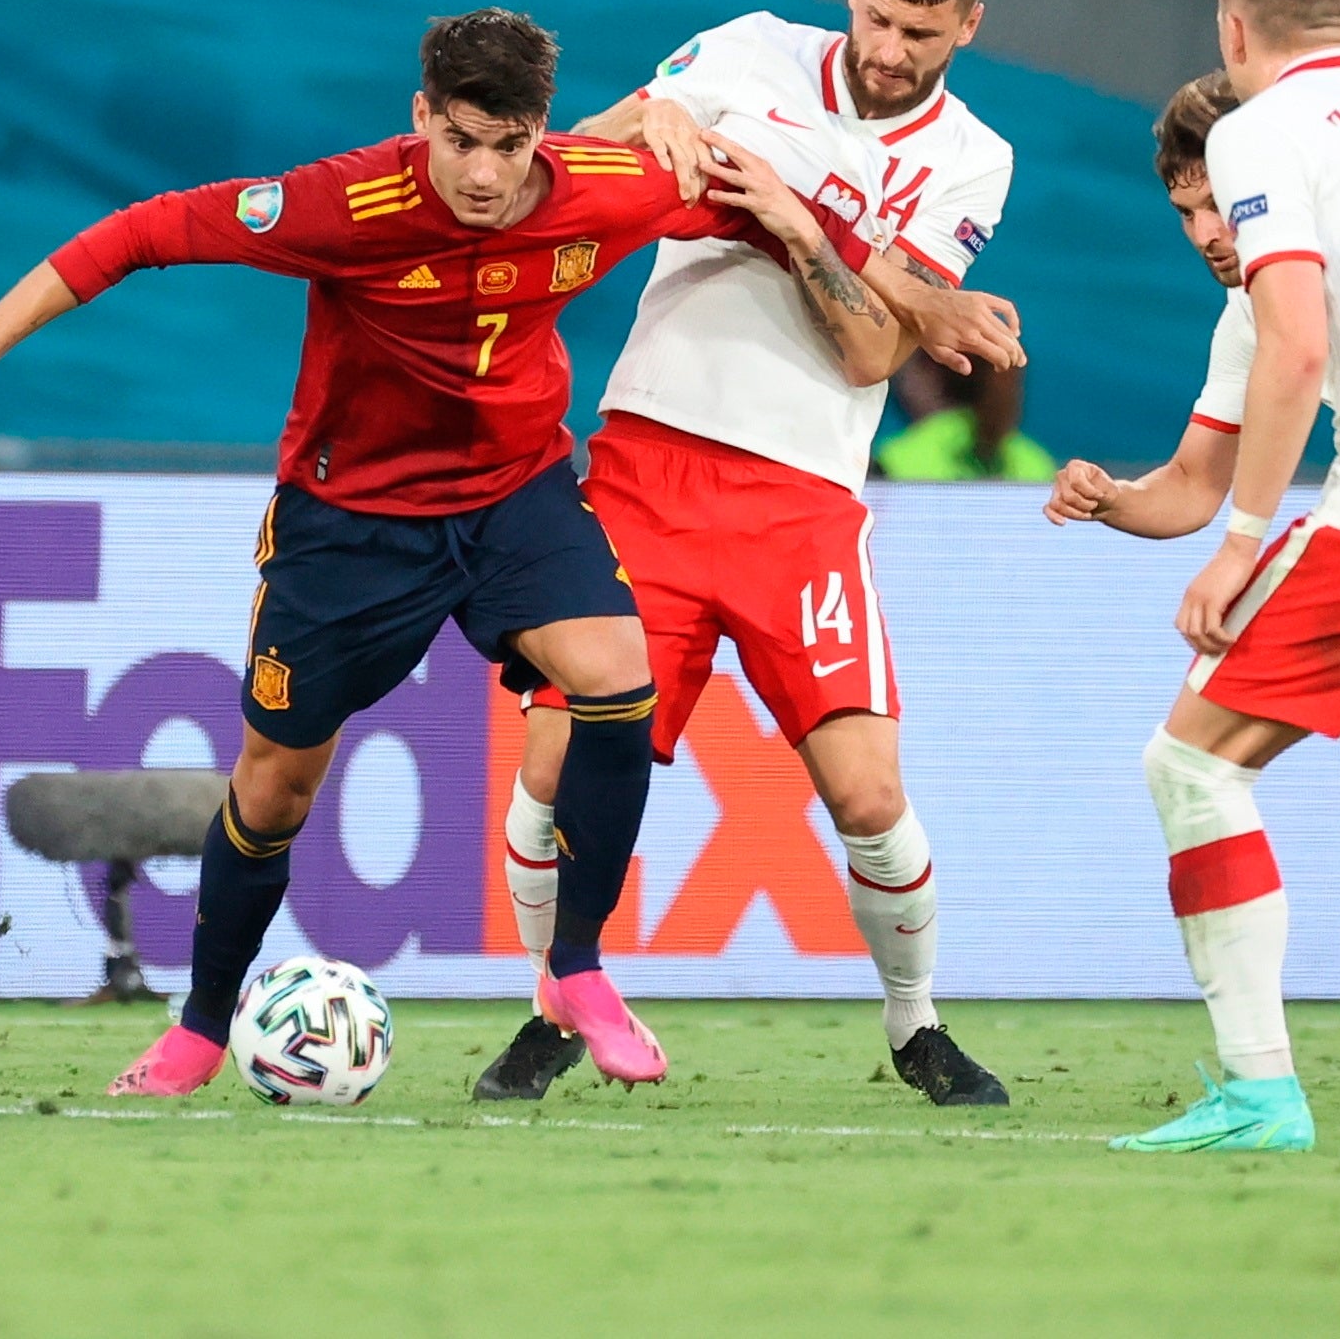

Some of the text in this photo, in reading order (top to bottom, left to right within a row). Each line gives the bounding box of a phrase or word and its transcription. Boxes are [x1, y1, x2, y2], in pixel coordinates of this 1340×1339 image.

[877, 155, 934, 232] 14
[967, 233, 986, 253] RES
[397, 278, 441, 290] adidas
[475, 312, 509, 377] 7
[799, 571, 855, 649] 14
